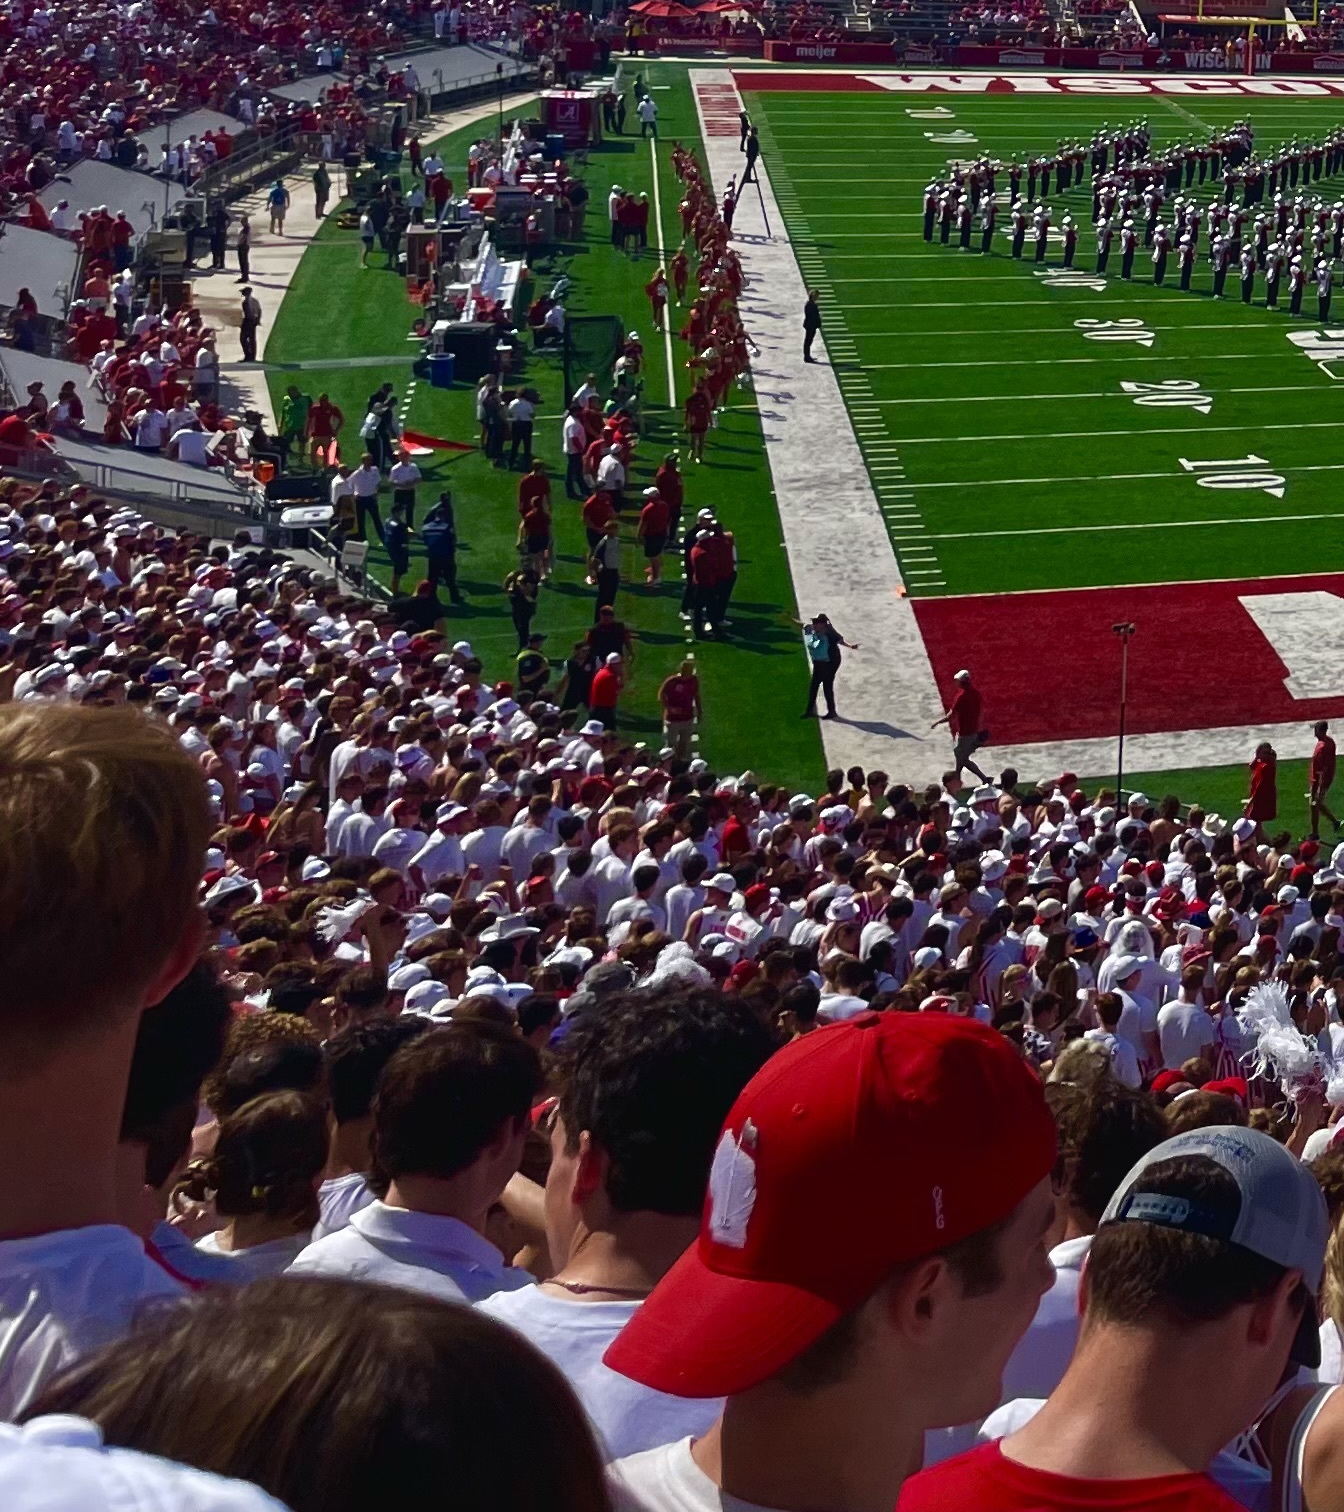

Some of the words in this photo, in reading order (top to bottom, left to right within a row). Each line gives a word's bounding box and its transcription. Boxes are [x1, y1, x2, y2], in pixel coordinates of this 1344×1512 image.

[796, 44, 836, 60] meijer
[1120, 378, 1214, 409] 20
[1178, 454, 1287, 491] 10
